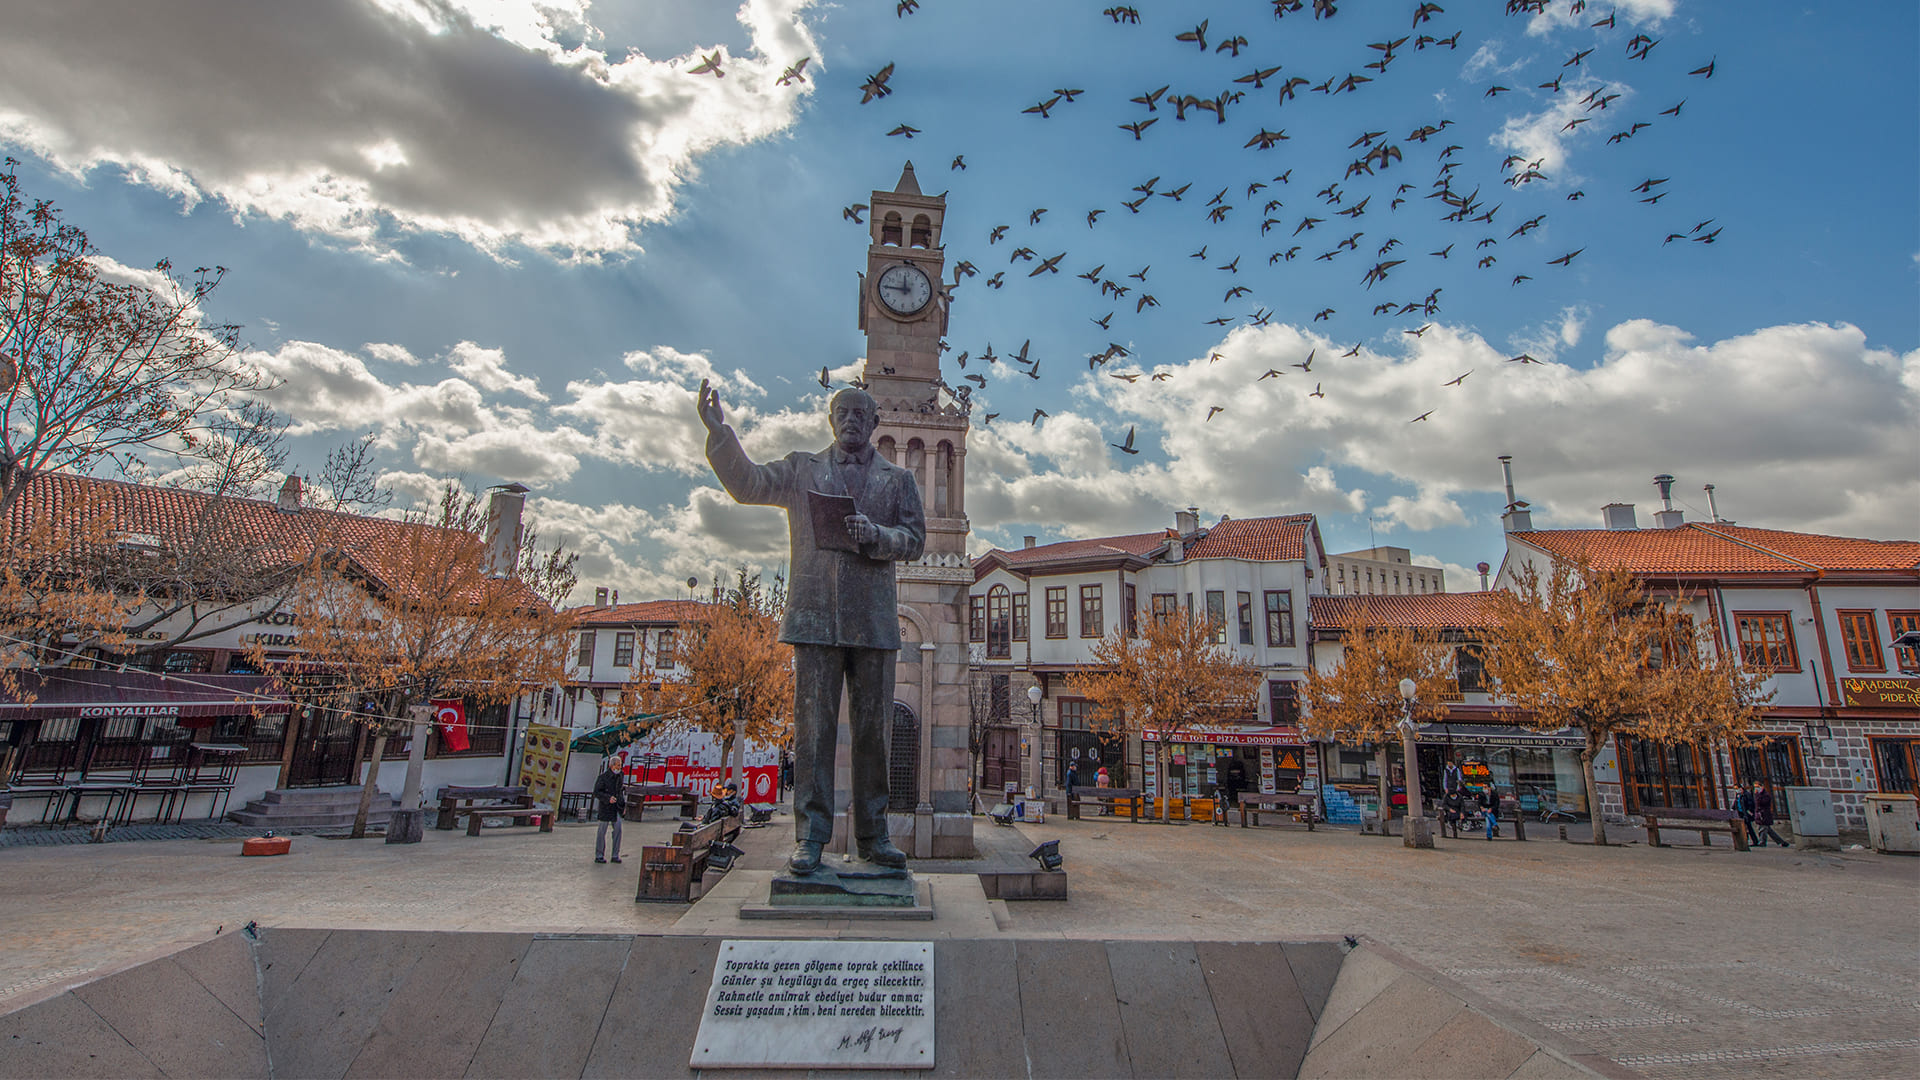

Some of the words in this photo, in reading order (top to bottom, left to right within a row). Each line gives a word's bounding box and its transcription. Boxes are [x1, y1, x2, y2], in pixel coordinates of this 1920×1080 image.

[80, 706, 179, 716] KONYALILAR
[1247, 736, 1293, 744] DONDURMA
[725, 960, 769, 972] Toprakta
[773, 962, 800, 972] gezen
[804, 960, 843, 973] gölgeme
[847, 960, 878, 973] toprak
[882, 960, 924, 973] çekilince
[722, 975, 757, 986] Günler
[761, 978, 773, 988] şu
[824, 976, 837, 986] da
[842, 978, 869, 988] ergeç
[874, 976, 924, 986] silecektir.
[718, 990, 764, 1002] Rahmetle
[814, 991, 854, 1004] ebediyet
[858, 992, 887, 1002] budur
[714, 1004, 743, 1016] Sessiz
[817, 1005, 837, 1016] beni
[840, 1005, 876, 1016] nereden
[880, 1005, 924, 1016] bilecektir.
